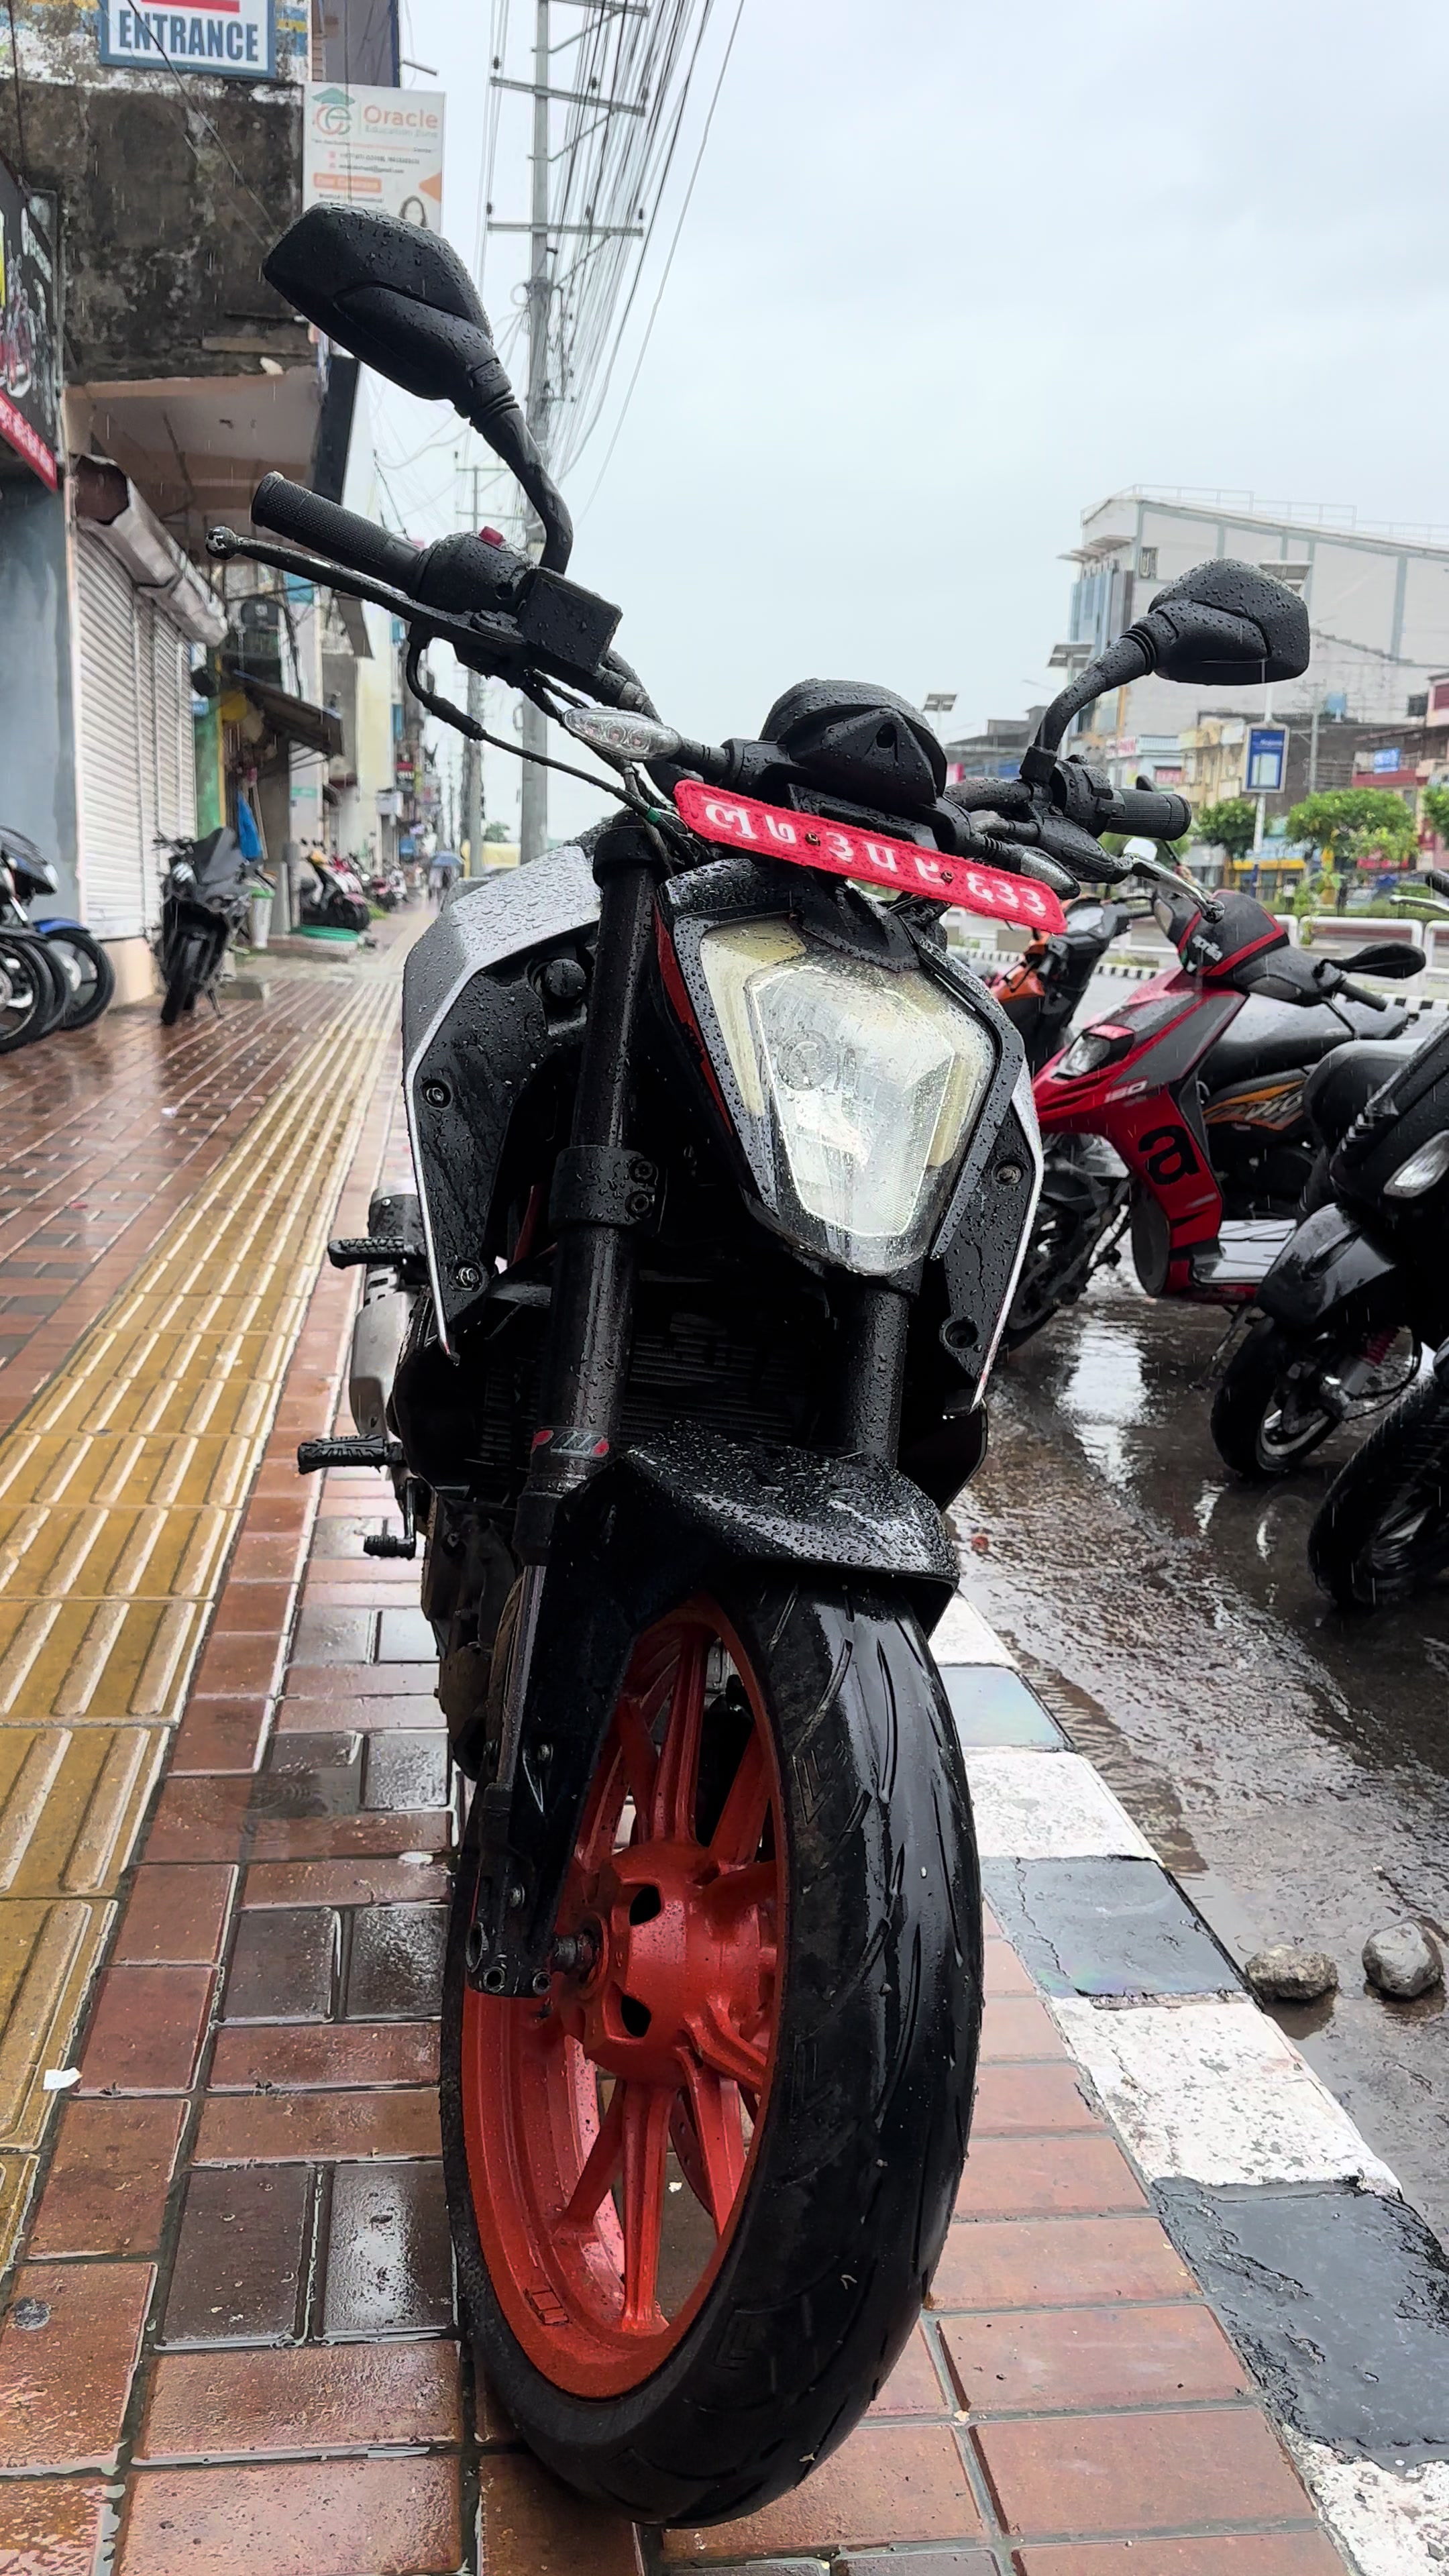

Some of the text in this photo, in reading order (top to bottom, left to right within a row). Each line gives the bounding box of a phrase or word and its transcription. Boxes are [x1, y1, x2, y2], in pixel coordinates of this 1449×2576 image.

[119, 9, 258, 62] ENTRANCE
[364, 105, 439, 129] Oracle
[1138, 1125, 1199, 1186] a
